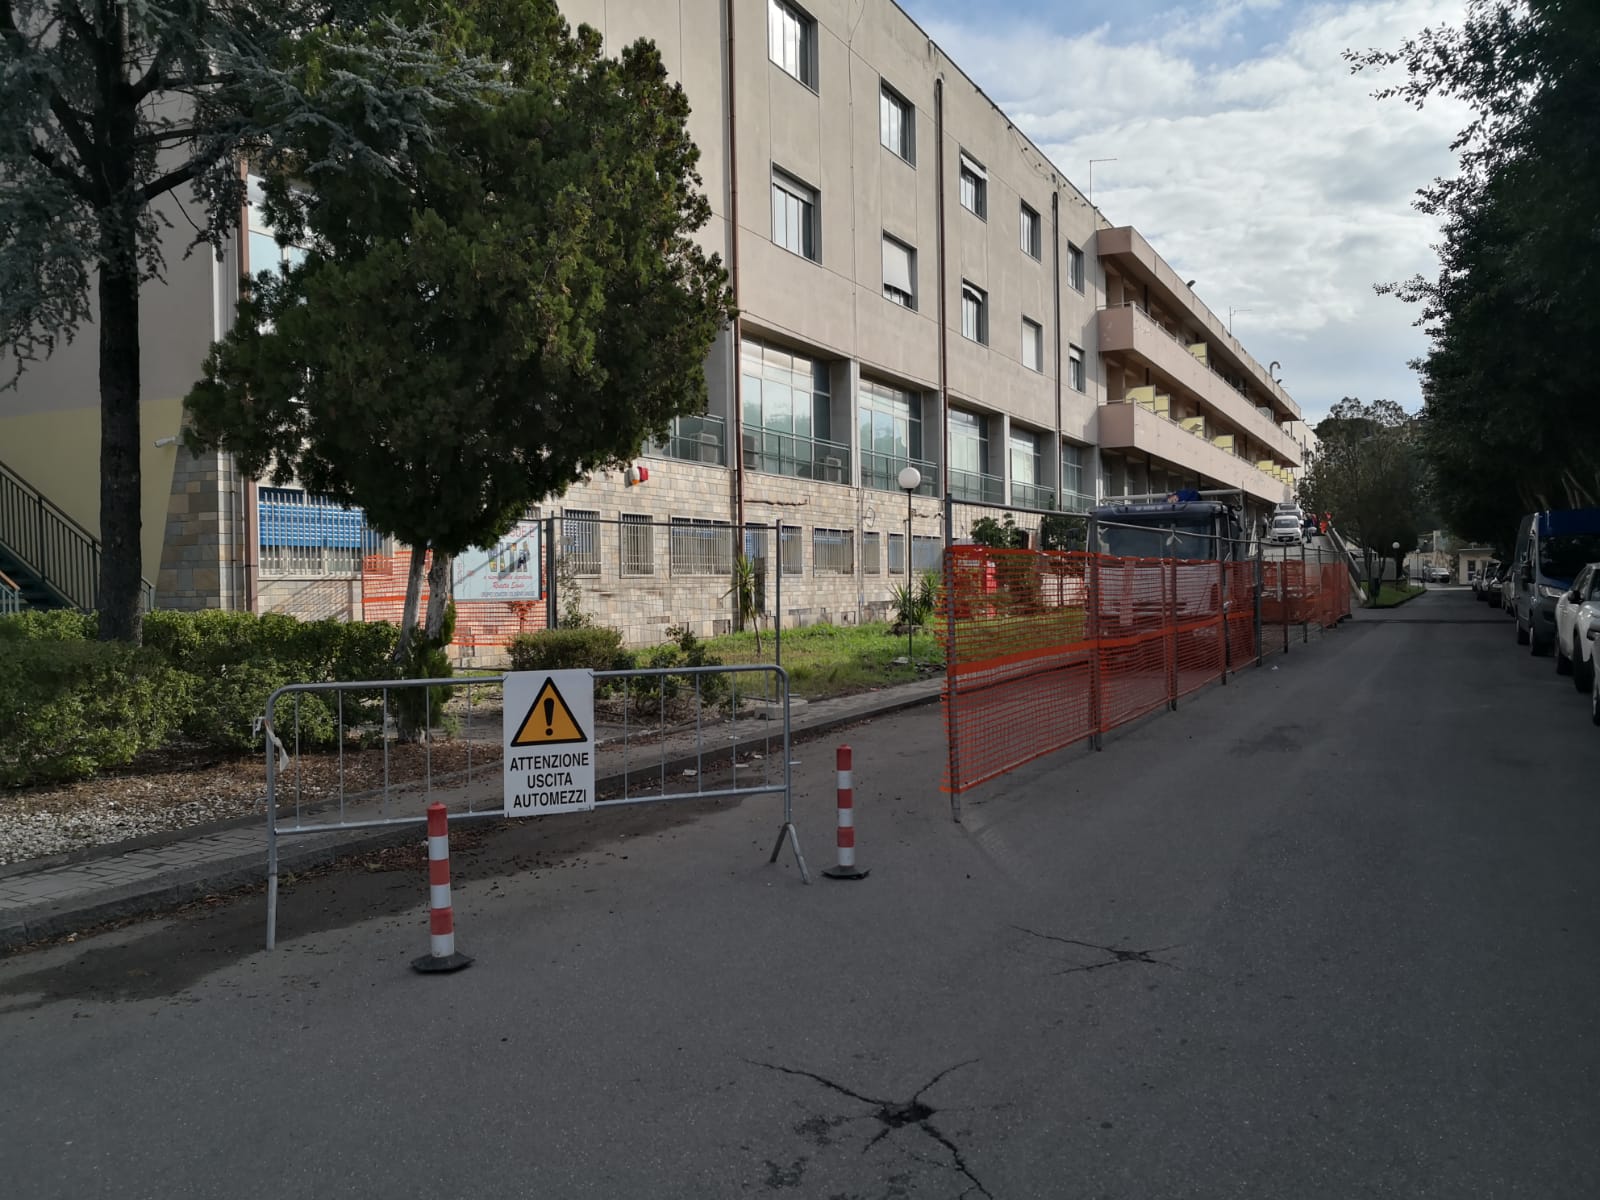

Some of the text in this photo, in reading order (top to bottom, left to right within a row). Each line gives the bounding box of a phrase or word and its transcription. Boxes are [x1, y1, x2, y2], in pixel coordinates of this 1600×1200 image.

[510, 752, 589, 771] ATTENZIONE
[528, 772, 573, 788] USCITA
[513, 789, 586, 808] AUTOMEZZI
